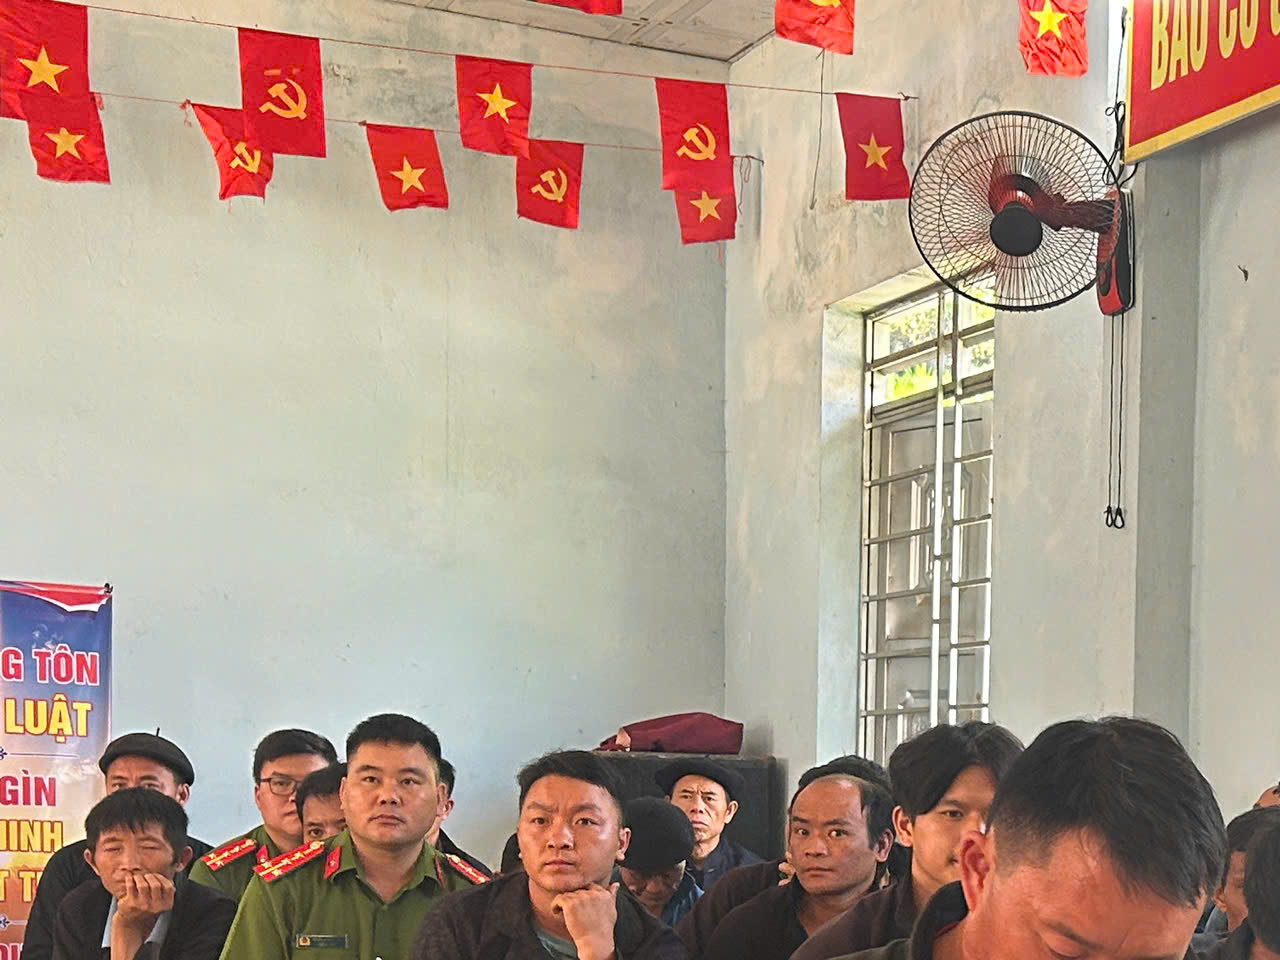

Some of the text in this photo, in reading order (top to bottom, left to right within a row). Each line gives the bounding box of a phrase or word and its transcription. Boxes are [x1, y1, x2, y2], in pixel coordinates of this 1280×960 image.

[33, 645, 99, 685] TÔN
[5, 693, 92, 743] LUẬT
[0, 769, 56, 806] GÌN
[18, 868, 43, 902] T
